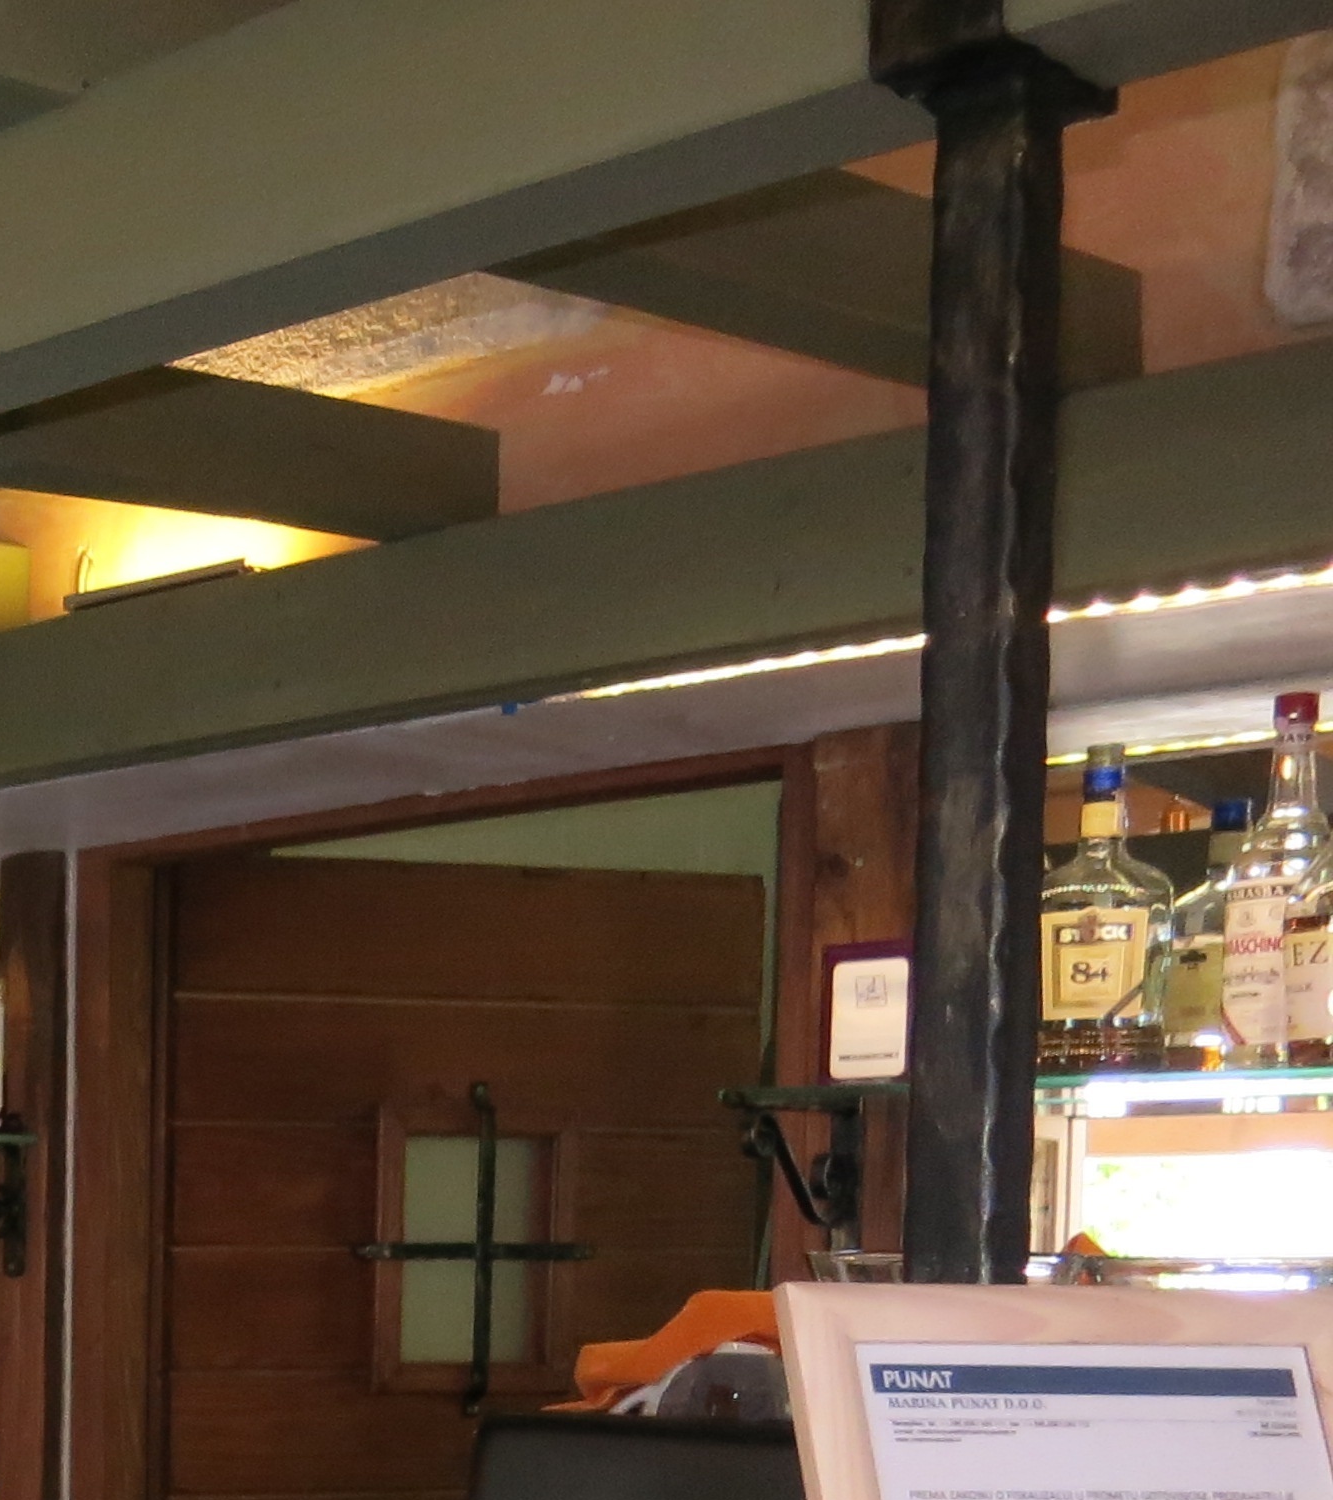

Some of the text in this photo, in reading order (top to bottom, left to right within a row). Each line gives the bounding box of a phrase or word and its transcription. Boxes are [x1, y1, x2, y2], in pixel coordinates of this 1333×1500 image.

[1070, 961, 1108, 985] 84
[882, 1370, 953, 1389] PUNAT
[888, 1398, 947, 1409] MARINA
[951, 1398, 999, 1410] PUNAT
